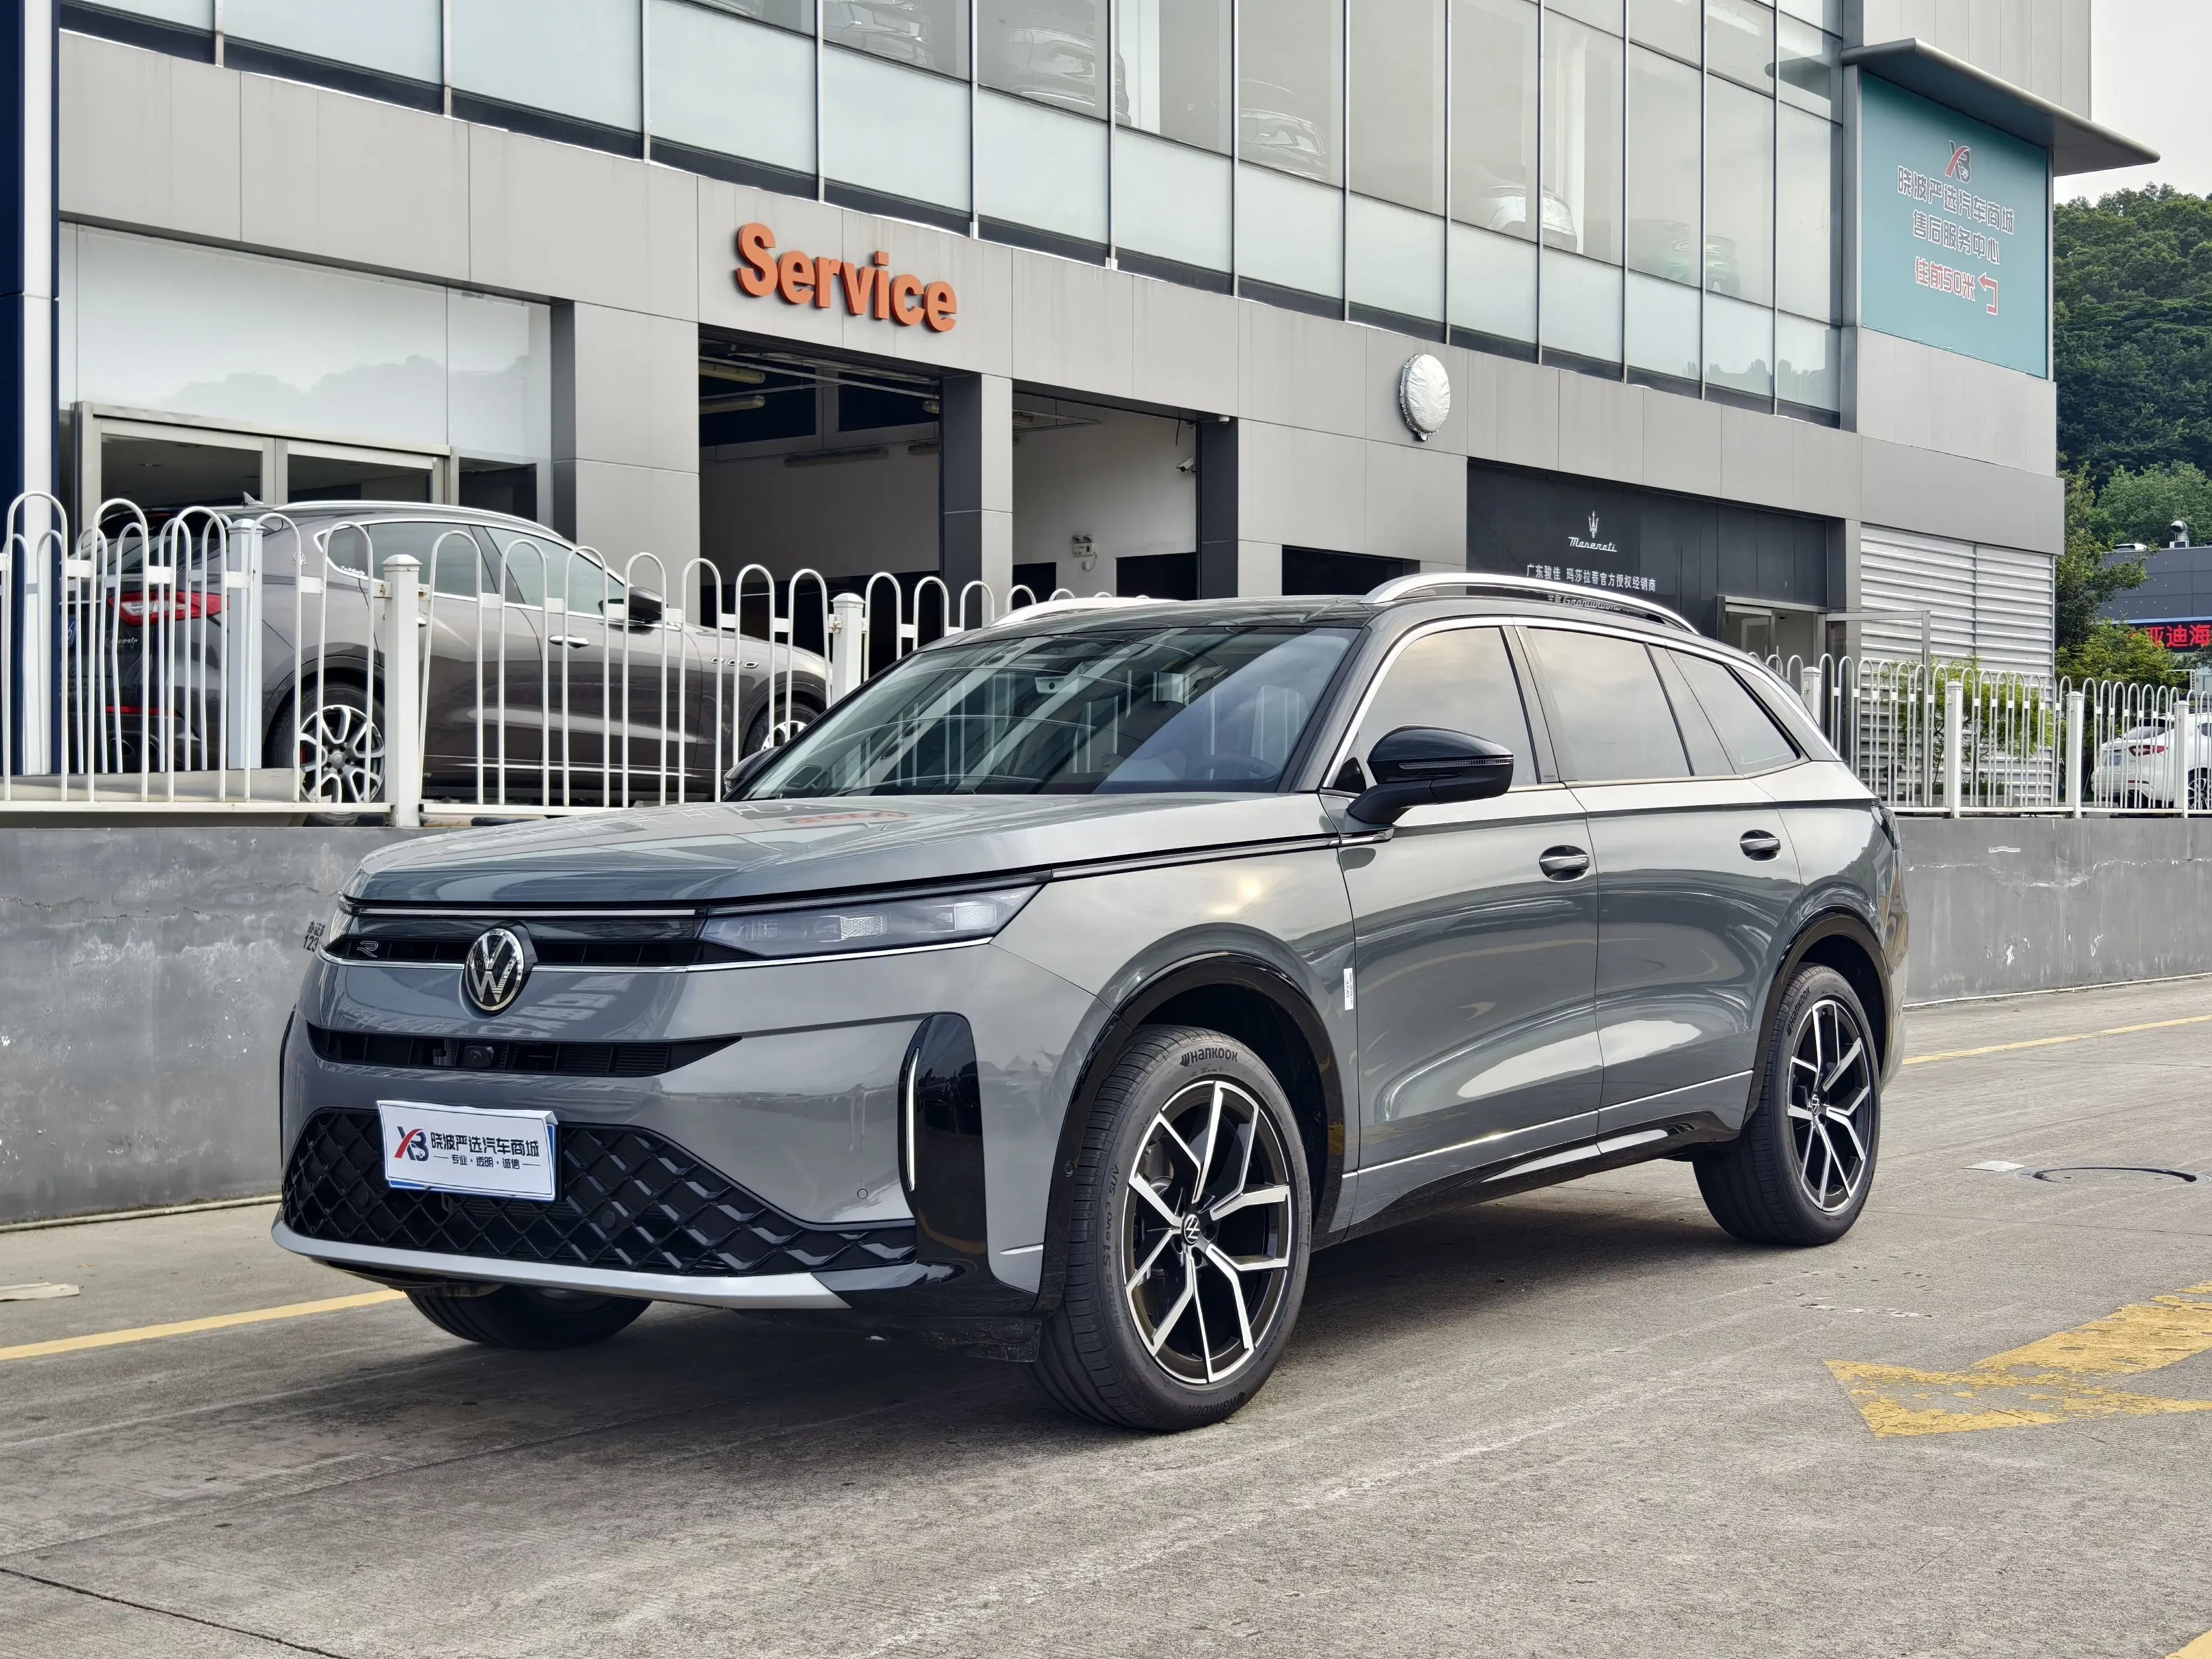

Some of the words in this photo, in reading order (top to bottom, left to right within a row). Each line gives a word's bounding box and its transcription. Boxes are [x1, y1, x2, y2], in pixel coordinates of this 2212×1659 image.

[1897, 165, 2014, 235] 晓波严选汽车商城
[1913, 210, 2000, 265] 售后服务中心
[737, 222, 957, 332] Service
[1568, 536, 1617, 552] Maserati
[1527, 563, 1561, 581] 广东骏佳
[1566, 568, 1656, 592] 玛莎拉蒂官方授权经销商
[430, 1131, 540, 1157] 晓波严选汽车商城
